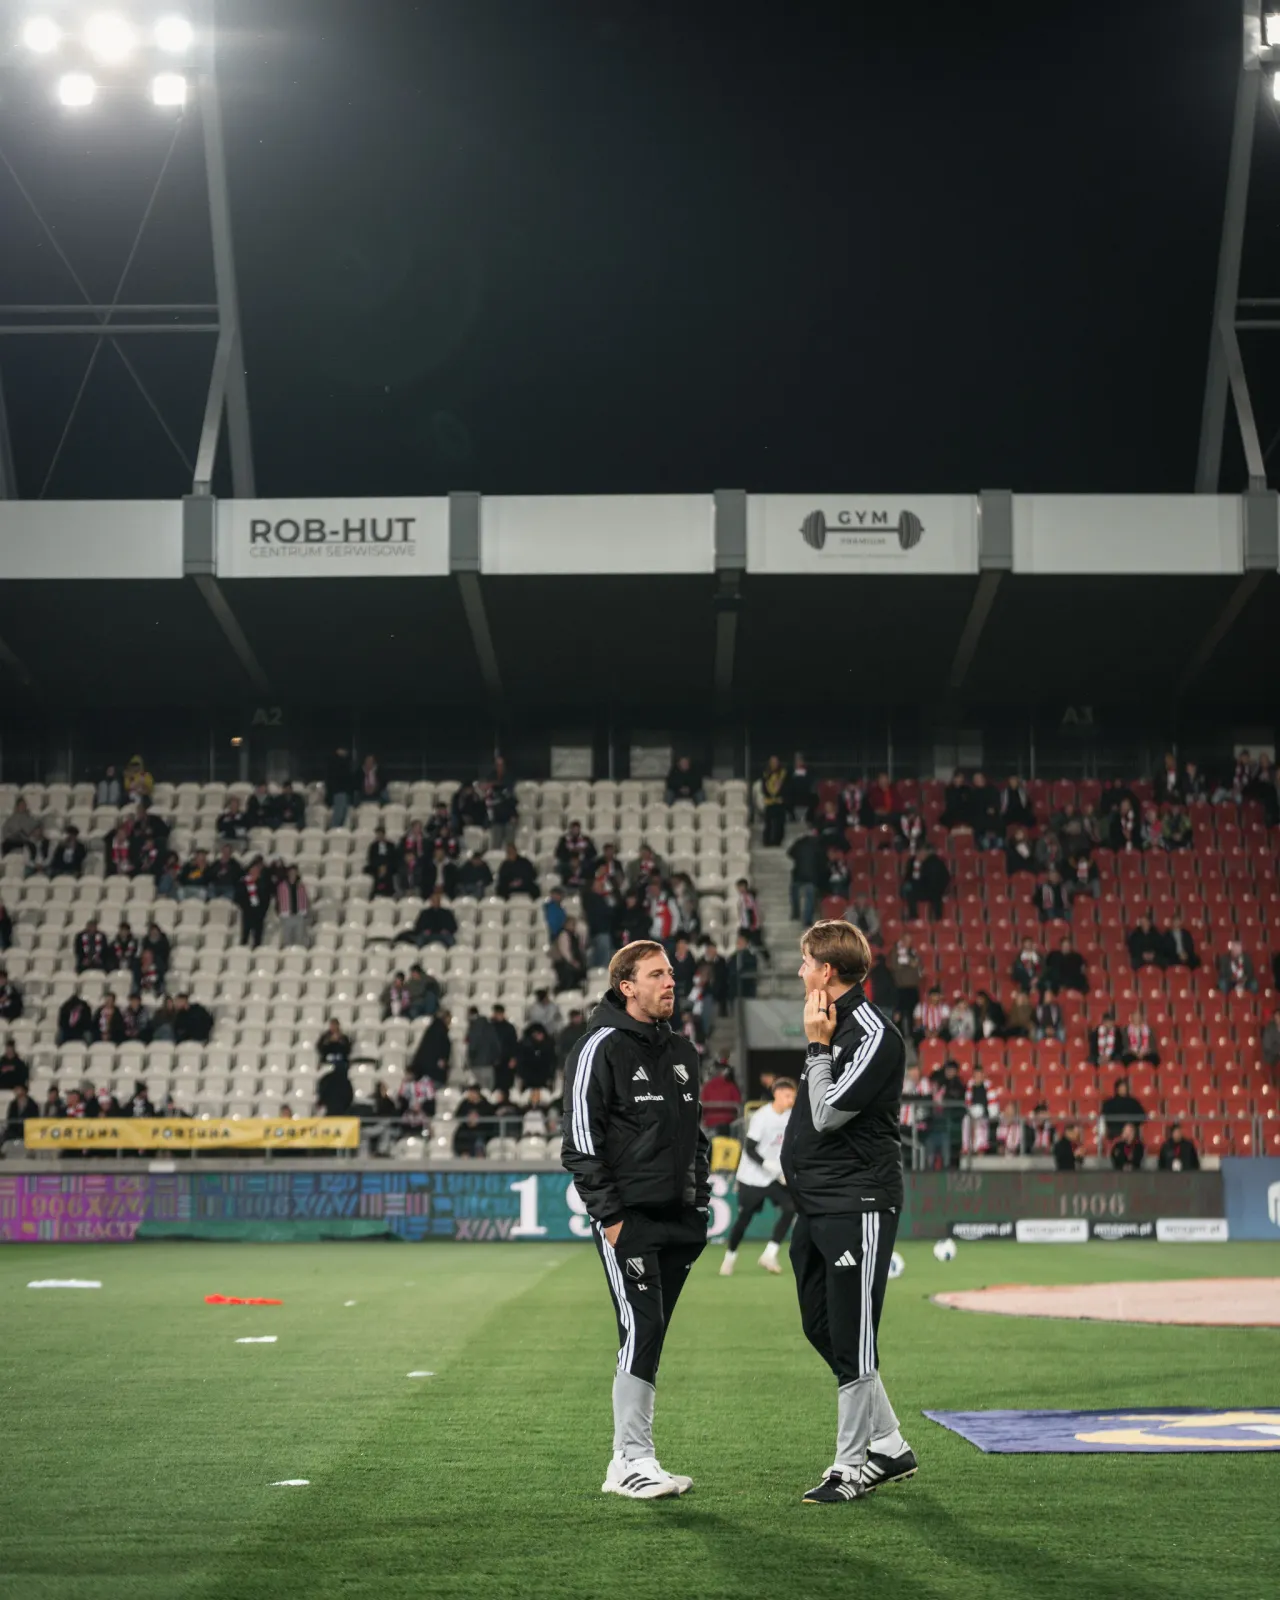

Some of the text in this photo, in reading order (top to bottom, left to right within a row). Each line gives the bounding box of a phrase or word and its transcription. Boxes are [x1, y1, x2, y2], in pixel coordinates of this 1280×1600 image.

[837, 510, 888, 525] GYM
[250, 517, 416, 543] ROB-HUT
[250, 544, 416, 558] CENTRUM SERWISOWE
[251, 706, 283, 726] A2
[40, 1126, 119, 1140] FORTUNA
[1059, 1193, 1126, 1217] 1906
